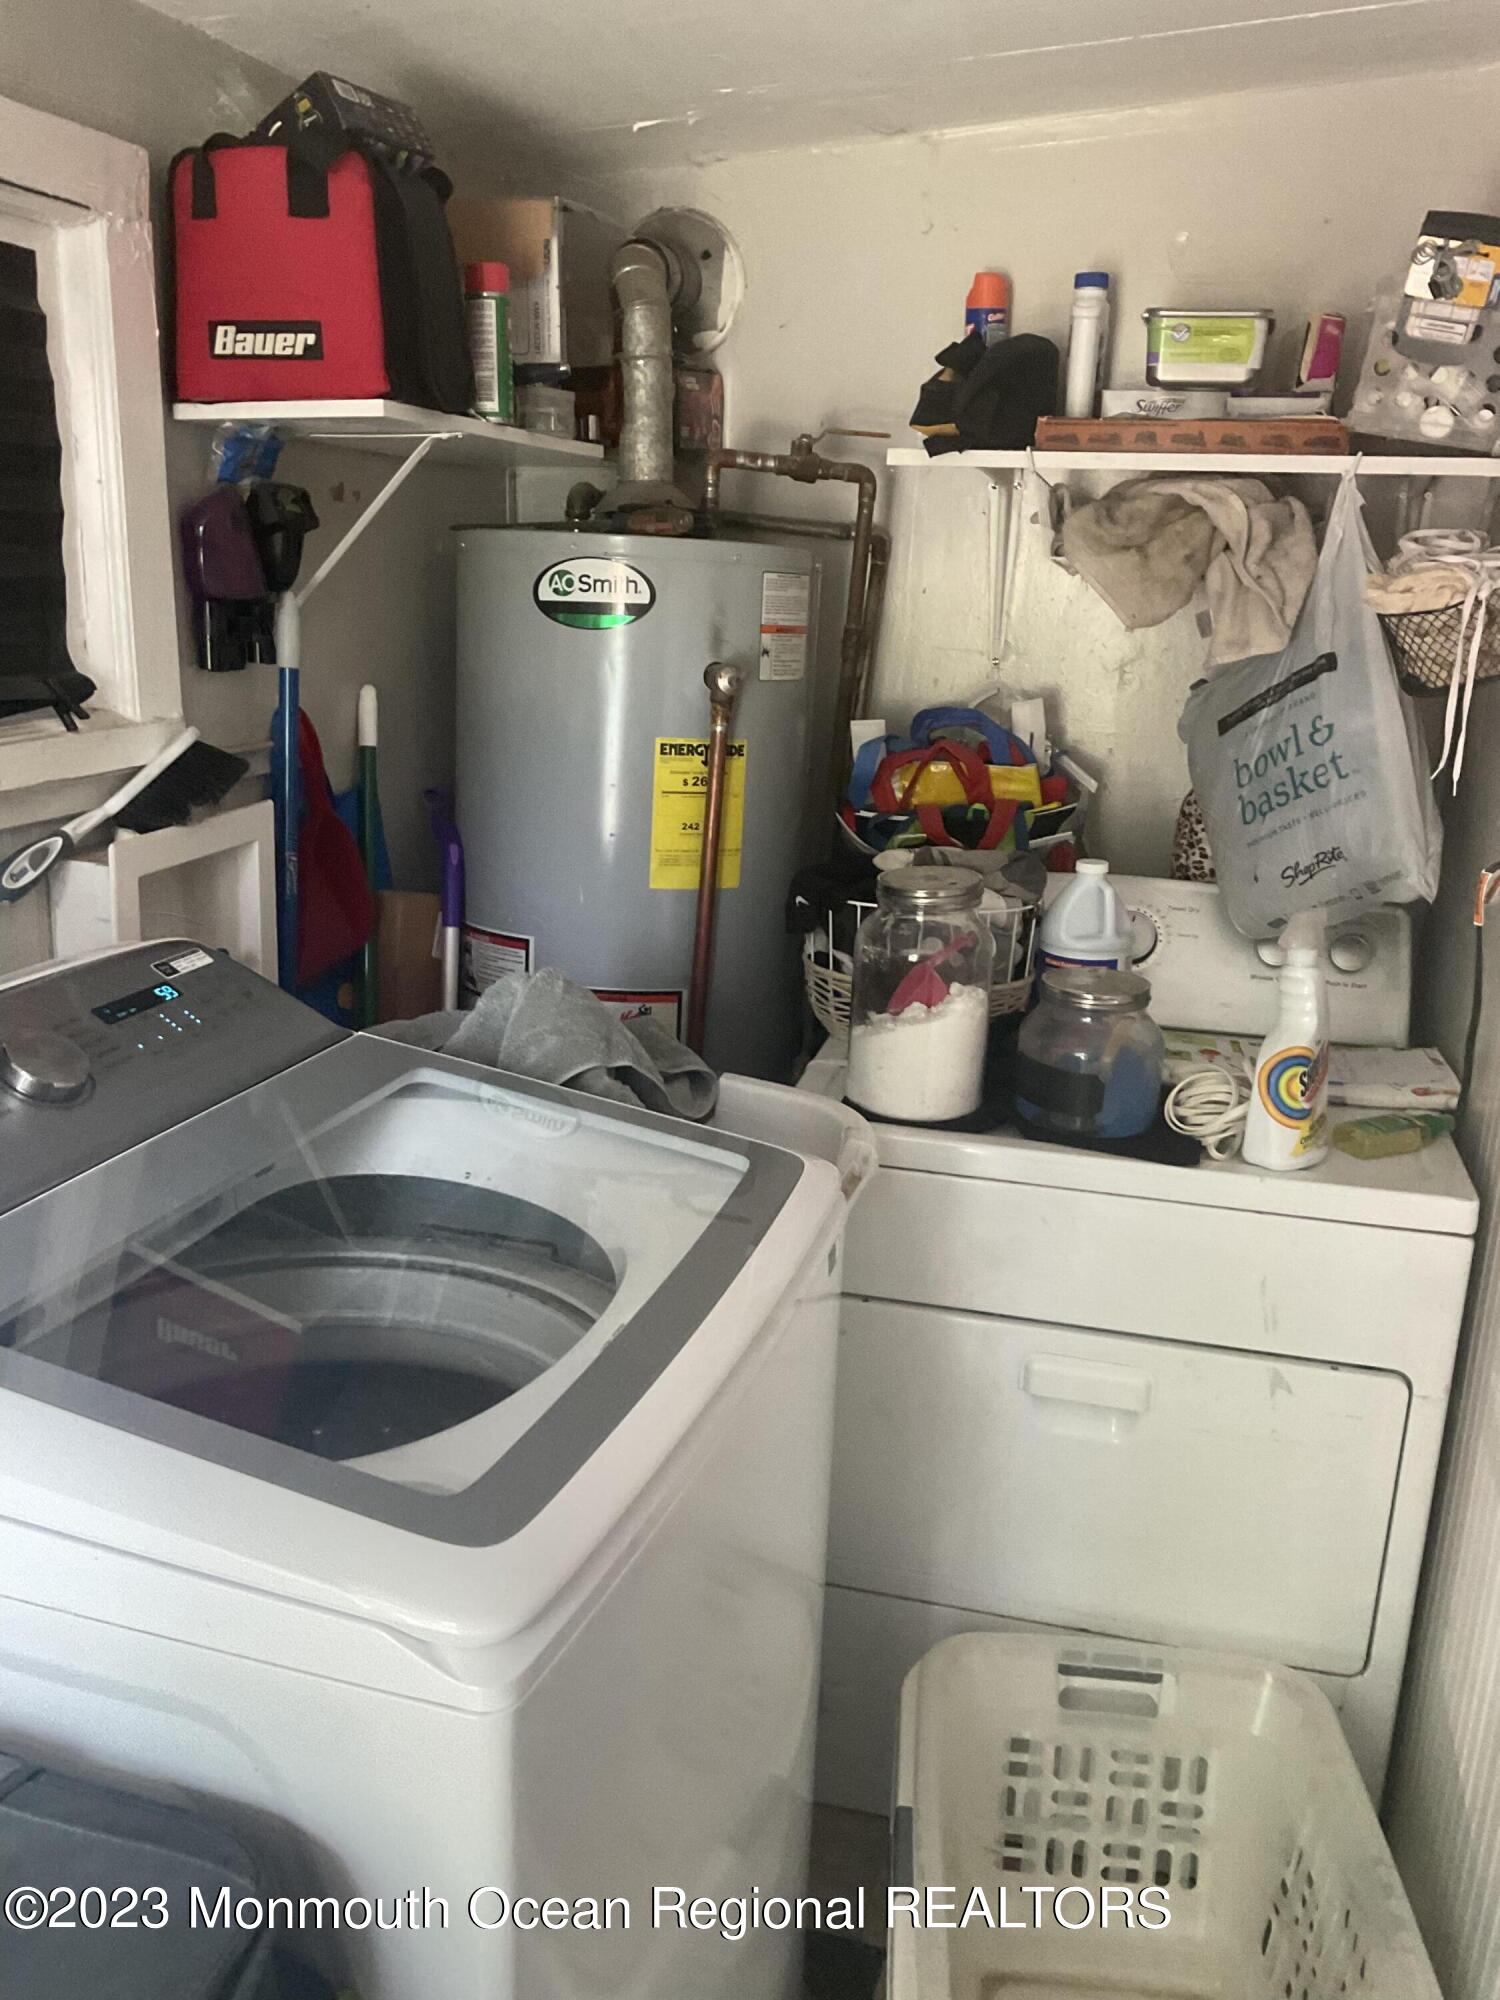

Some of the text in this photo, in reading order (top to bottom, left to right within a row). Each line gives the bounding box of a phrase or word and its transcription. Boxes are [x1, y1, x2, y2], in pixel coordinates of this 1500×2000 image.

[214, 325, 316, 356] Bauer
[1136, 399, 1185, 419] Swiffer
[578, 574, 639, 595] Smih
[1234, 723, 1304, 788] bowl
[1308, 714, 1335, 747] &
[1237, 750, 1350, 826] basket
[681, 822, 700, 831] 242
[1281, 846, 1345, 888] ShopRite
